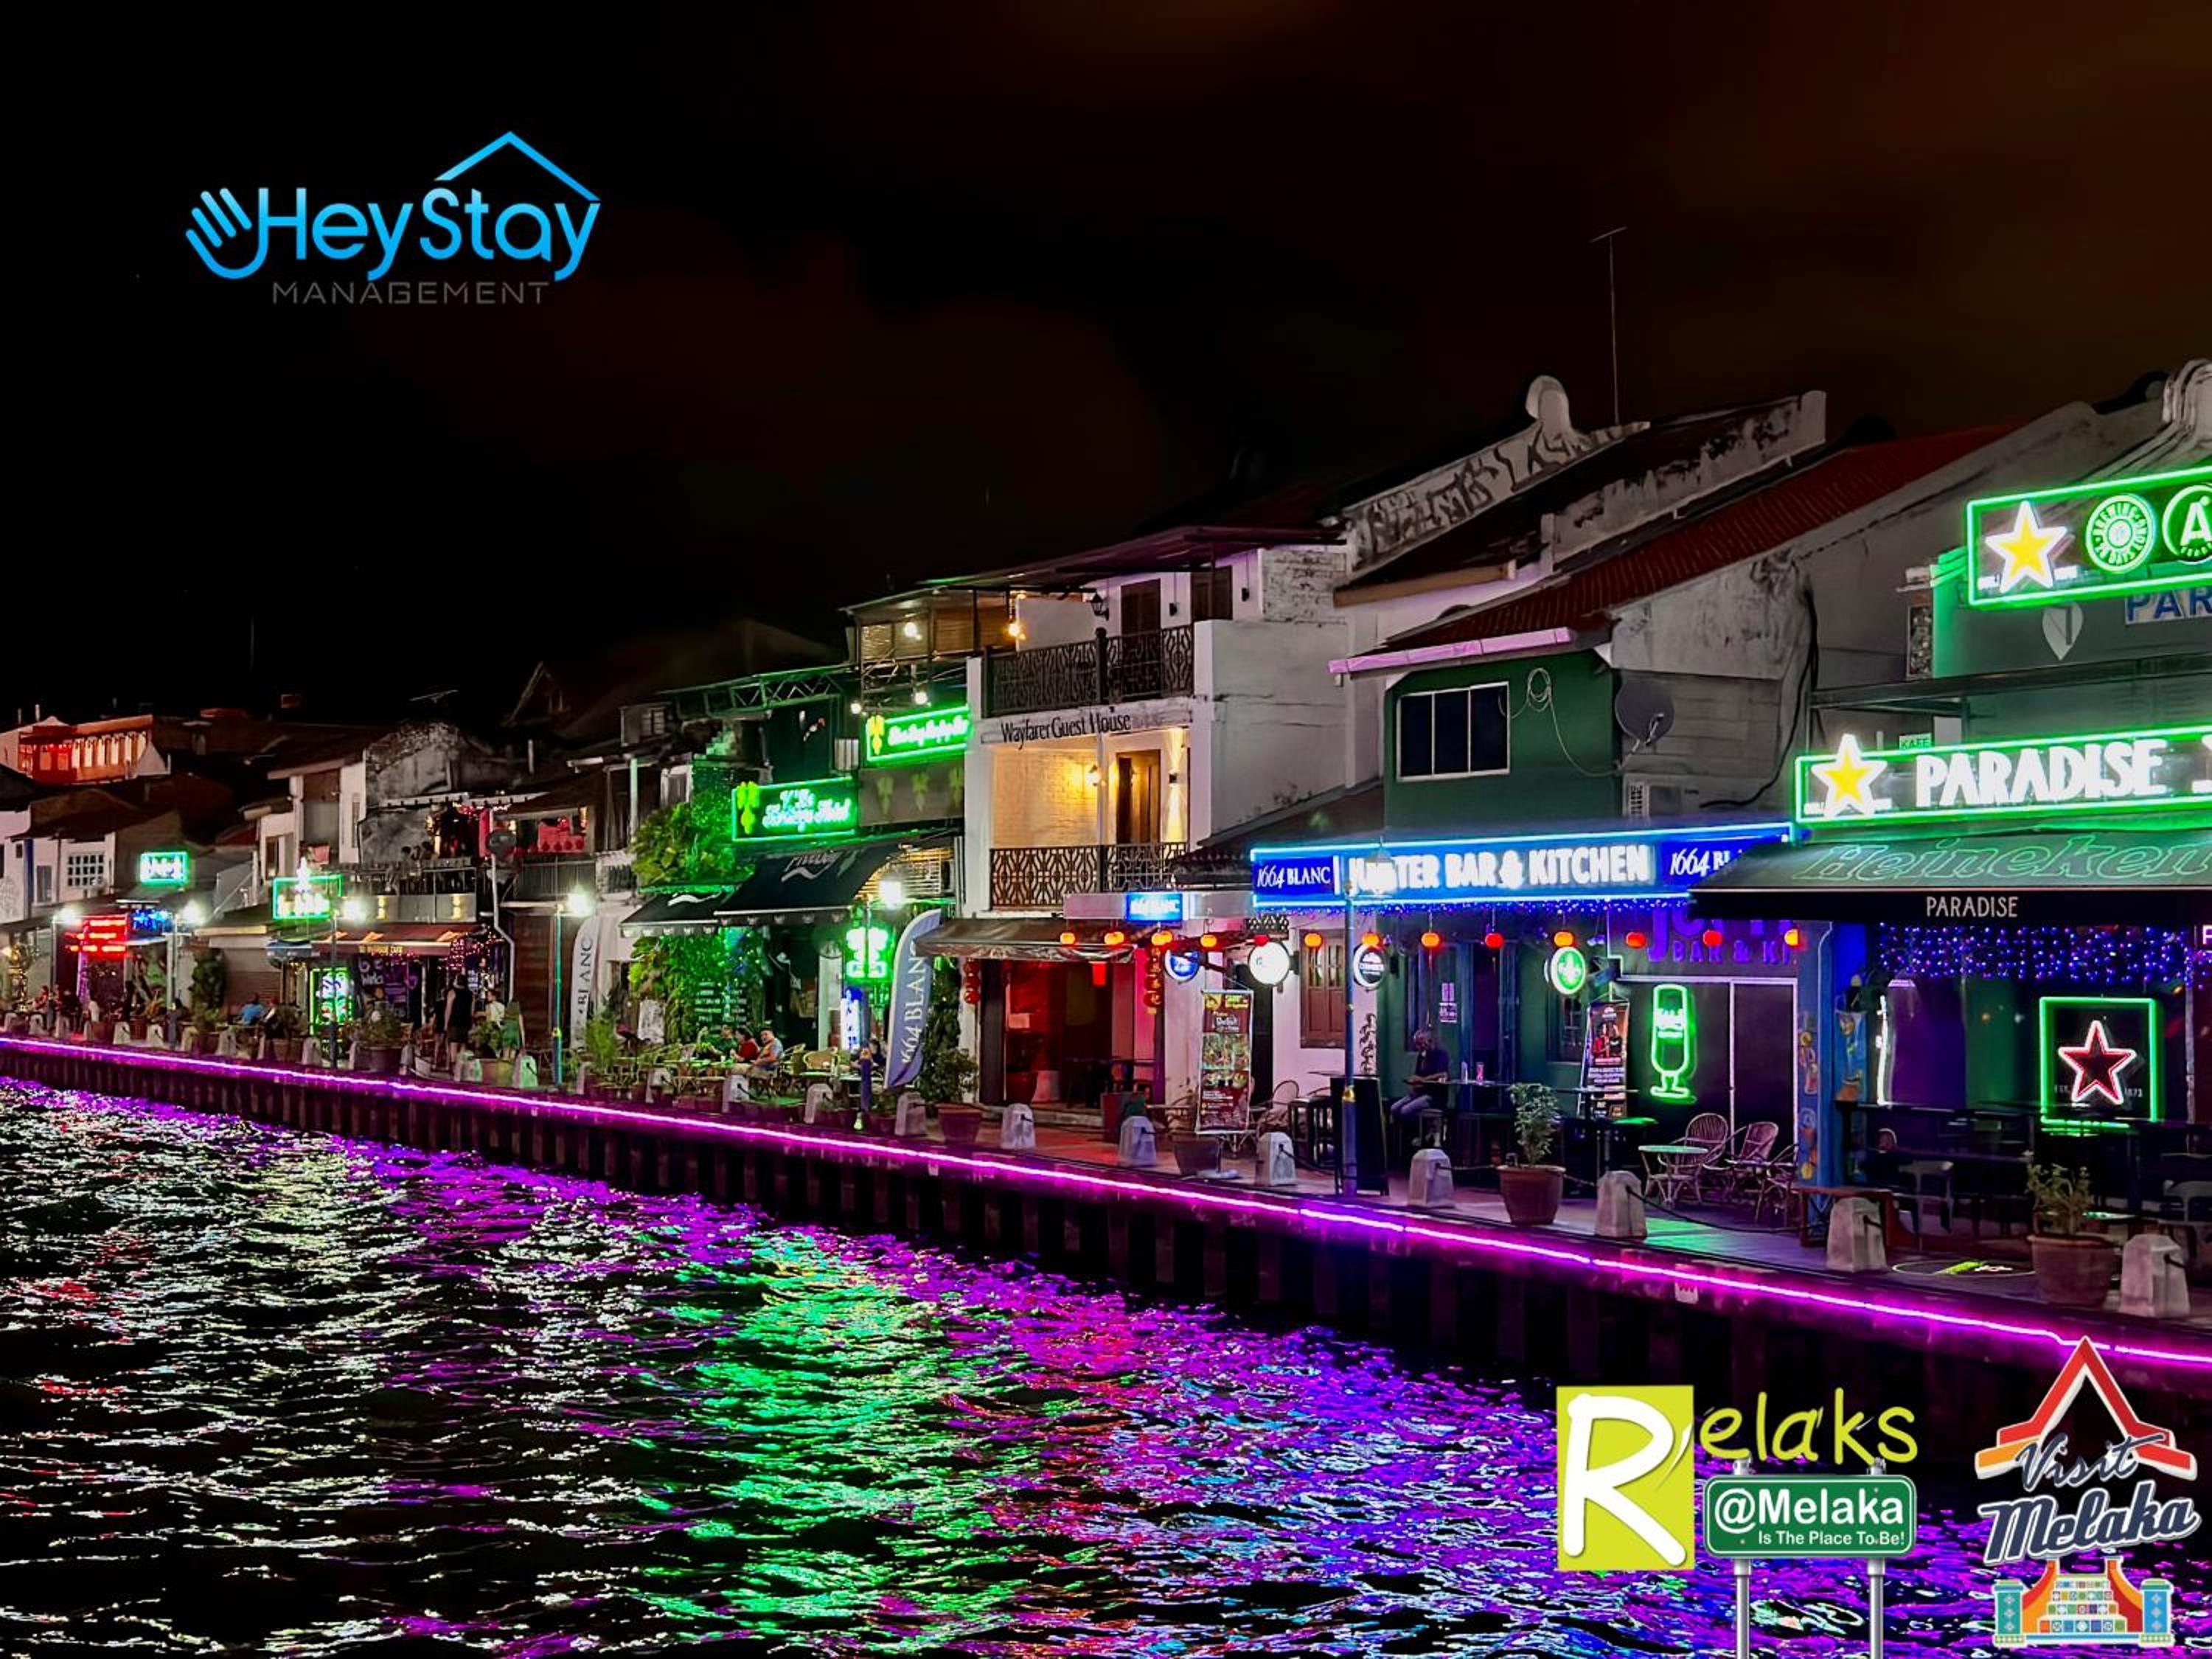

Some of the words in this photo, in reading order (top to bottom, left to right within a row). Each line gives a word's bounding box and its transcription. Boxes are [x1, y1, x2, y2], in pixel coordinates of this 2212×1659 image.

[1001, 718, 1050, 751] Wayfarer
[1051, 716, 1087, 738] Guest
[1089, 712, 1131, 734] House
[1916, 739, 2168, 807] PARADISE
[1256, 865, 1284, 888] 1664
[1286, 866, 1331, 886] BLANC
[1445, 850, 1499, 889] BAR
[1528, 844, 1650, 886] KITCHEN
[1669, 847, 1711, 877] 1664
[1793, 834, 2212, 881] Heineken
[1927, 896, 2019, 918] PARADISE
